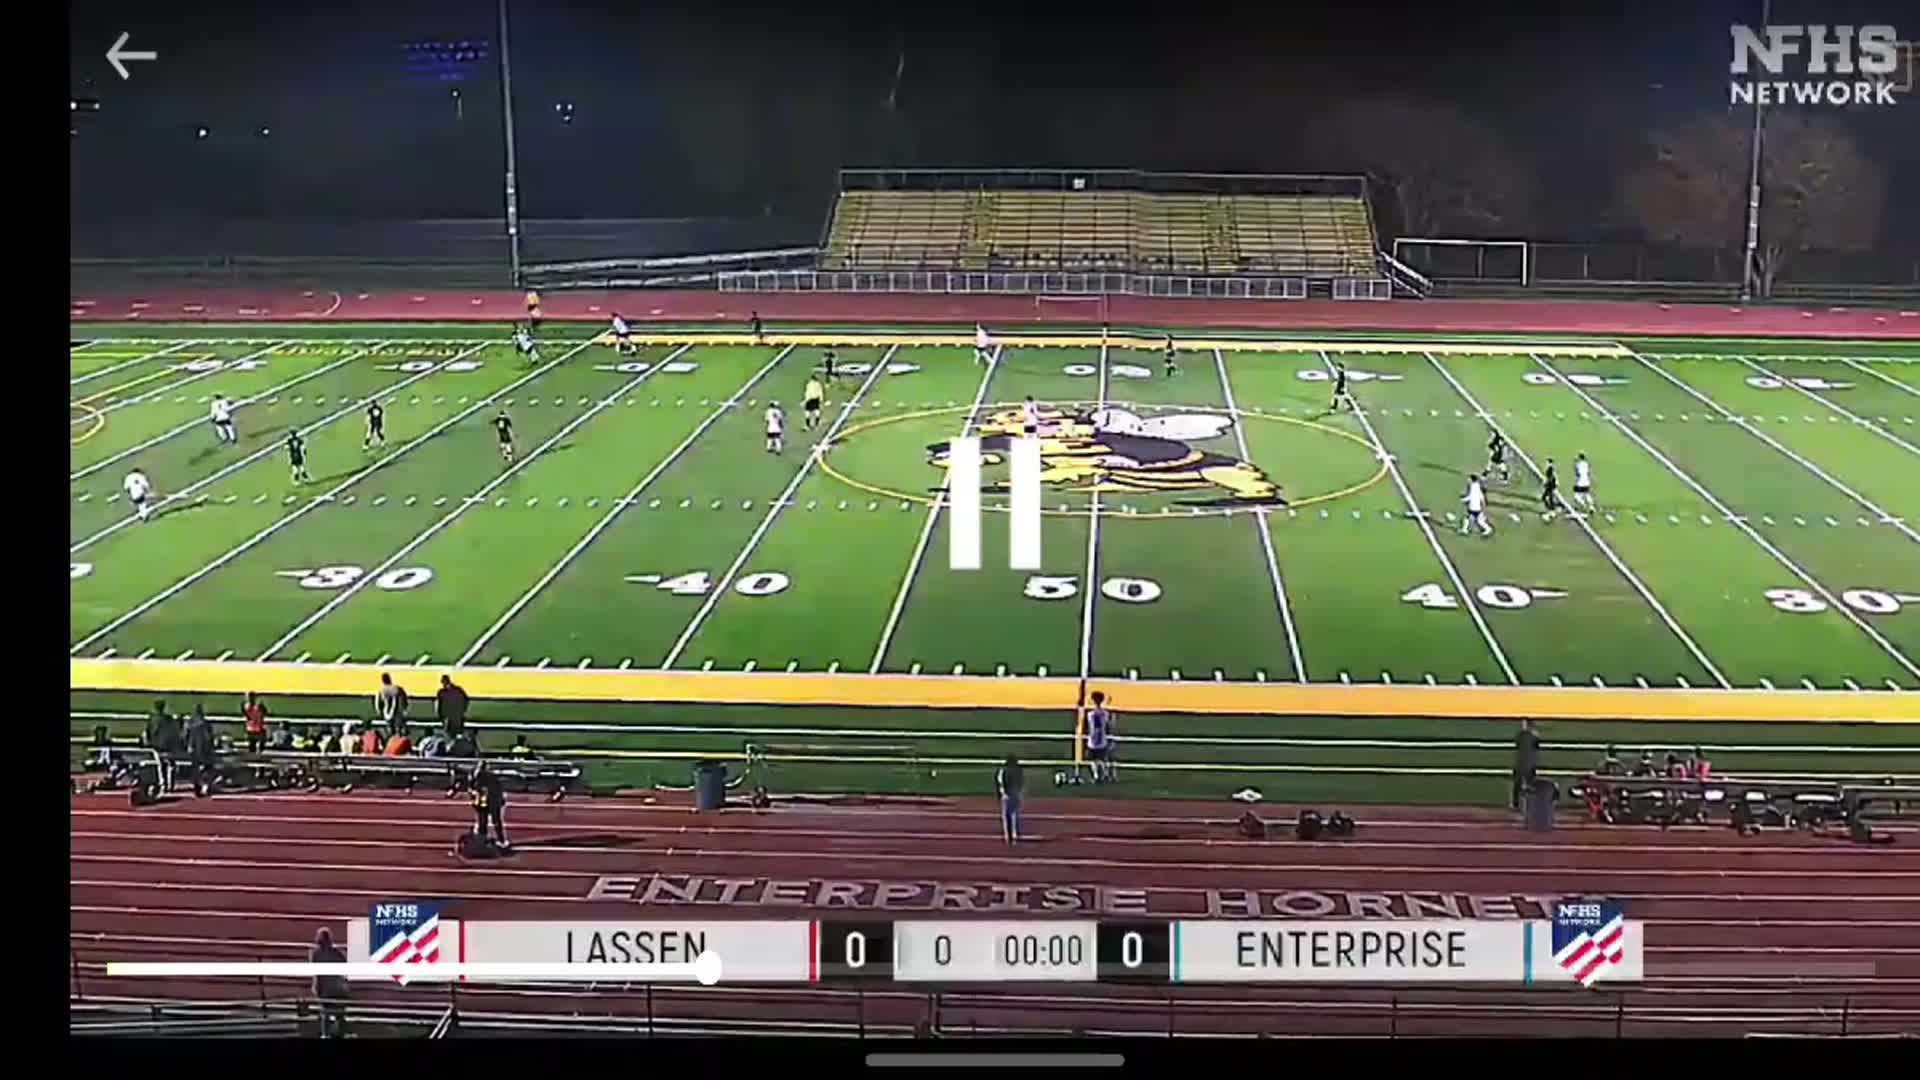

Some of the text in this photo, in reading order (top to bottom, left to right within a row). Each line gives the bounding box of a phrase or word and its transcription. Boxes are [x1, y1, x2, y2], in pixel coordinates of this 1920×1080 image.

[656, 571, 790, 595] 40
[1023, 575, 1162, 602] 50
[1402, 583, 1532, 608] 40
[586, 874, 1606, 920] ENTERPRISE HORNET
